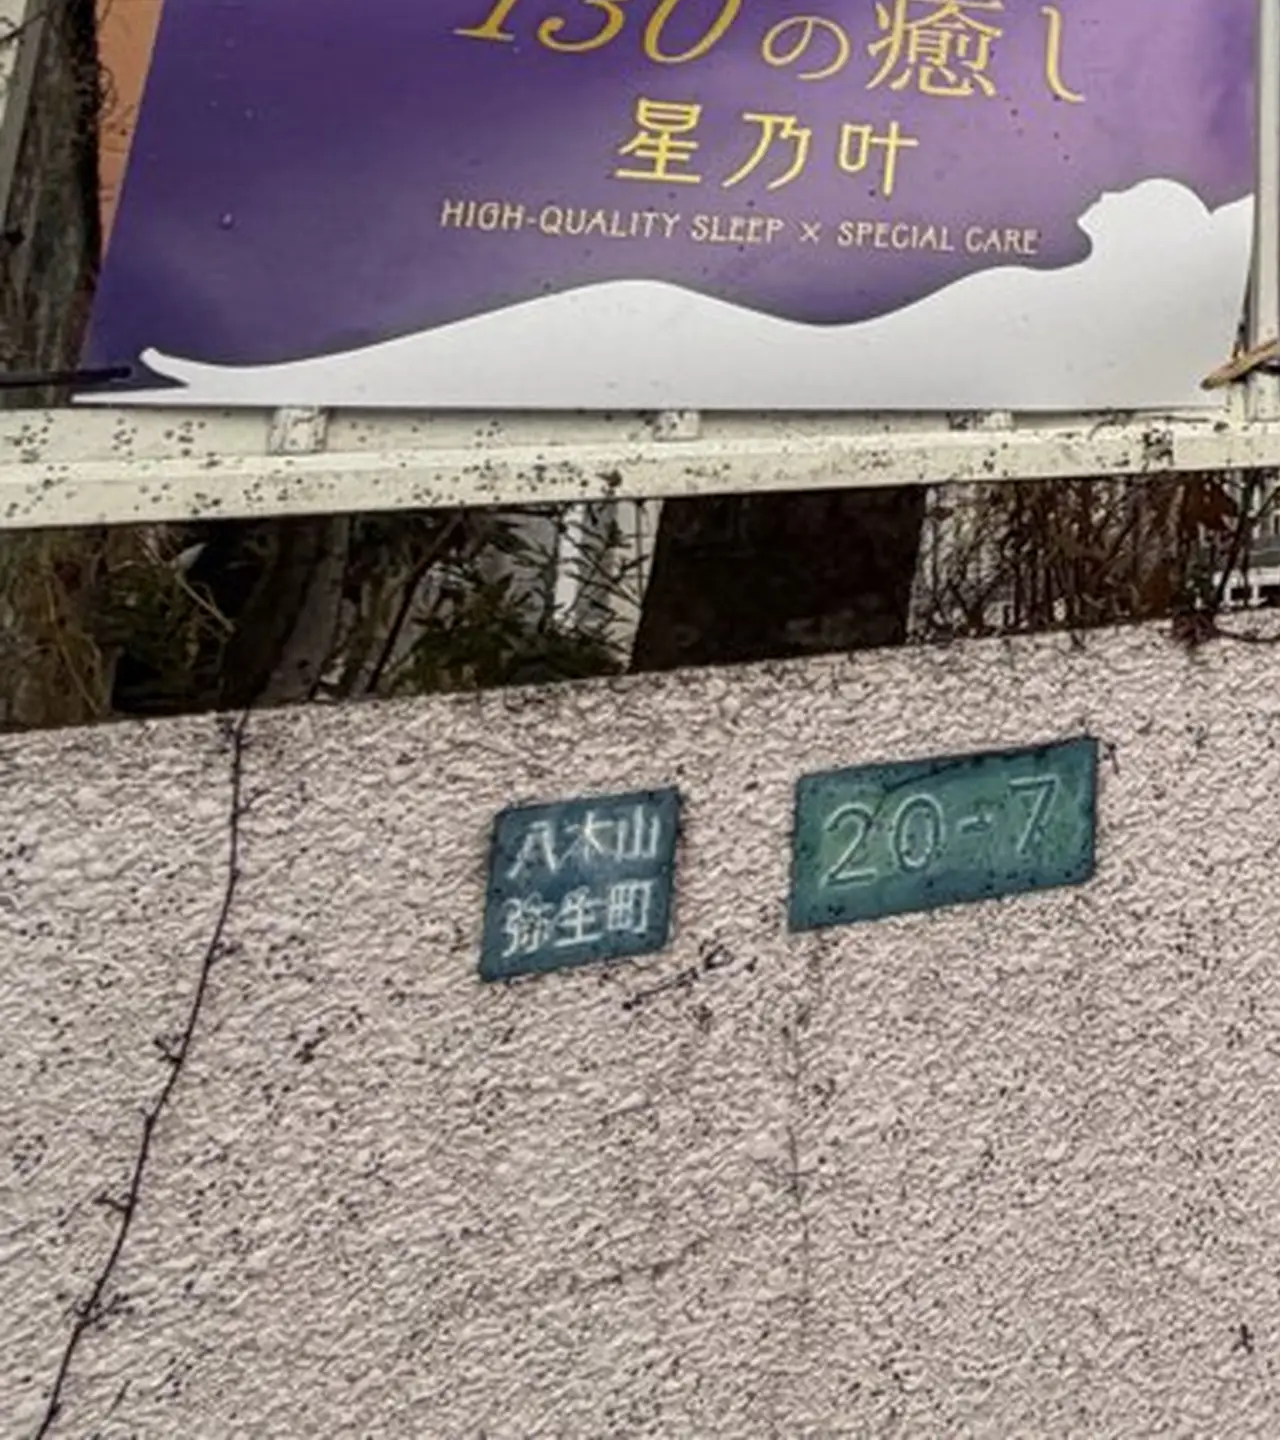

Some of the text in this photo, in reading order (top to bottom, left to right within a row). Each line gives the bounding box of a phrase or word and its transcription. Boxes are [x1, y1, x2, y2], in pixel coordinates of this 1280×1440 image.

[614, 97, 920, 197] 星乃叶
[440, 200, 681, 241] HIGH-QUALITY
[690, 213, 786, 245] SLEEP
[836, 220, 955, 254] SPECIAL
[963, 224, 1040, 256] CARE
[506, 805, 661, 879] 八木山
[818, 774, 1061, 890] 20-7
[502, 879, 653, 958] 弥生町
